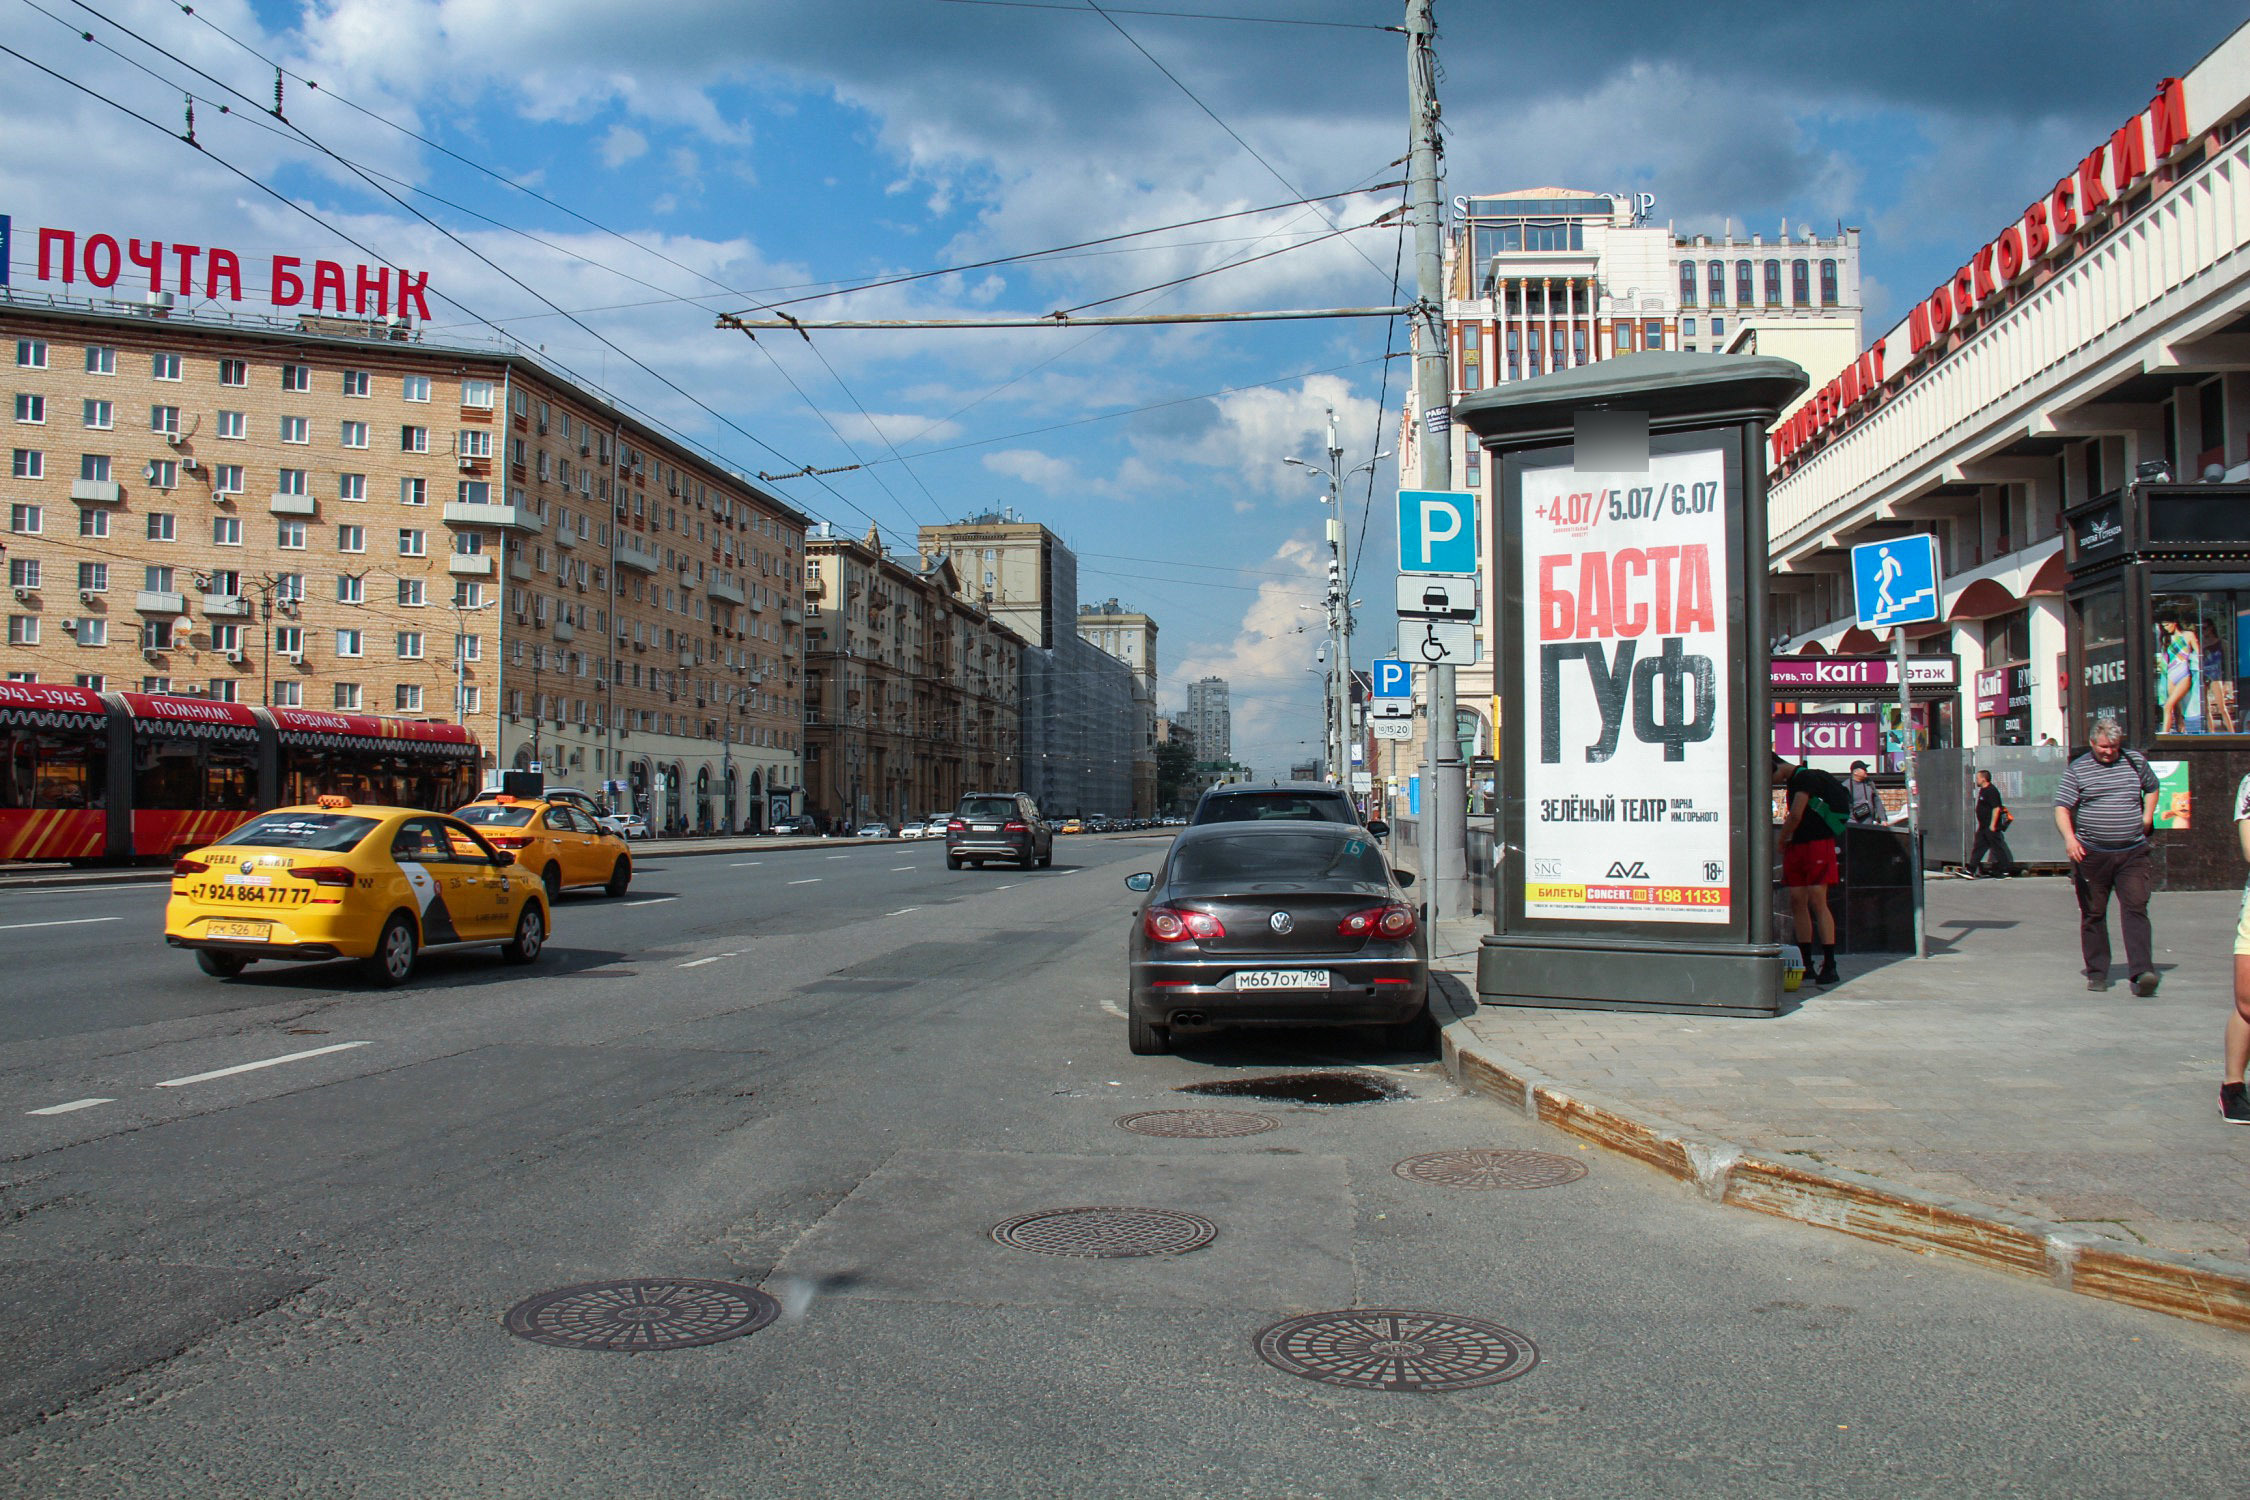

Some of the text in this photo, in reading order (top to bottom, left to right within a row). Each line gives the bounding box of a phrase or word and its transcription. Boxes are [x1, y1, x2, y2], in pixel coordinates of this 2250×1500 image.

[38, 227, 432, 321] ПОЧТА БАНК
[1769, 77, 2190, 465] УНИВЕРМАГ МОСКОВСКИЙ
[1420, 500, 1462, 563] P
[1539, 544, 1715, 640] БАСТА
[1383, 664, 1403, 693] P
[1800, 672, 1814, 681] ТО
[1816, 661, 1868, 682] kari
[1906, 669, 1945, 679] этаж
[2084, 660, 2126, 687] PRICE
[1978, 670, 2002, 698] kari
[0, 686, 88, 707] 941-1945
[1540, 637, 1716, 764] ГУФ
[152, 700, 234, 721] ПОМНИМ!
[282, 712, 350, 730] ГОРДИМСЯ
[1386, 725, 1394, 733] 15
[1396, 725, 1408, 734] 20
[1794, 720, 1863, 749] kari
[2005, 719, 2020, 730] ВХОД
[1540, 794, 1667, 822] ЗЕЛЁНЫЙ ТЕАТР
[1670, 798, 1693, 809] ПАРКА
[204, 855, 237, 864] АРЕНДА
[1534, 862, 1562, 875] SNC
[1704, 862, 1723, 881] 18+
[191, 884, 311, 904] +7 924 864 77 77
[1538, 887, 1583, 898] БИЛЕТЫ
[1655, 888, 1682, 903] 198
[1685, 889, 1721, 904] 1133
[231, 924, 249, 935] 526
[1302, 970, 1325, 981] 790
